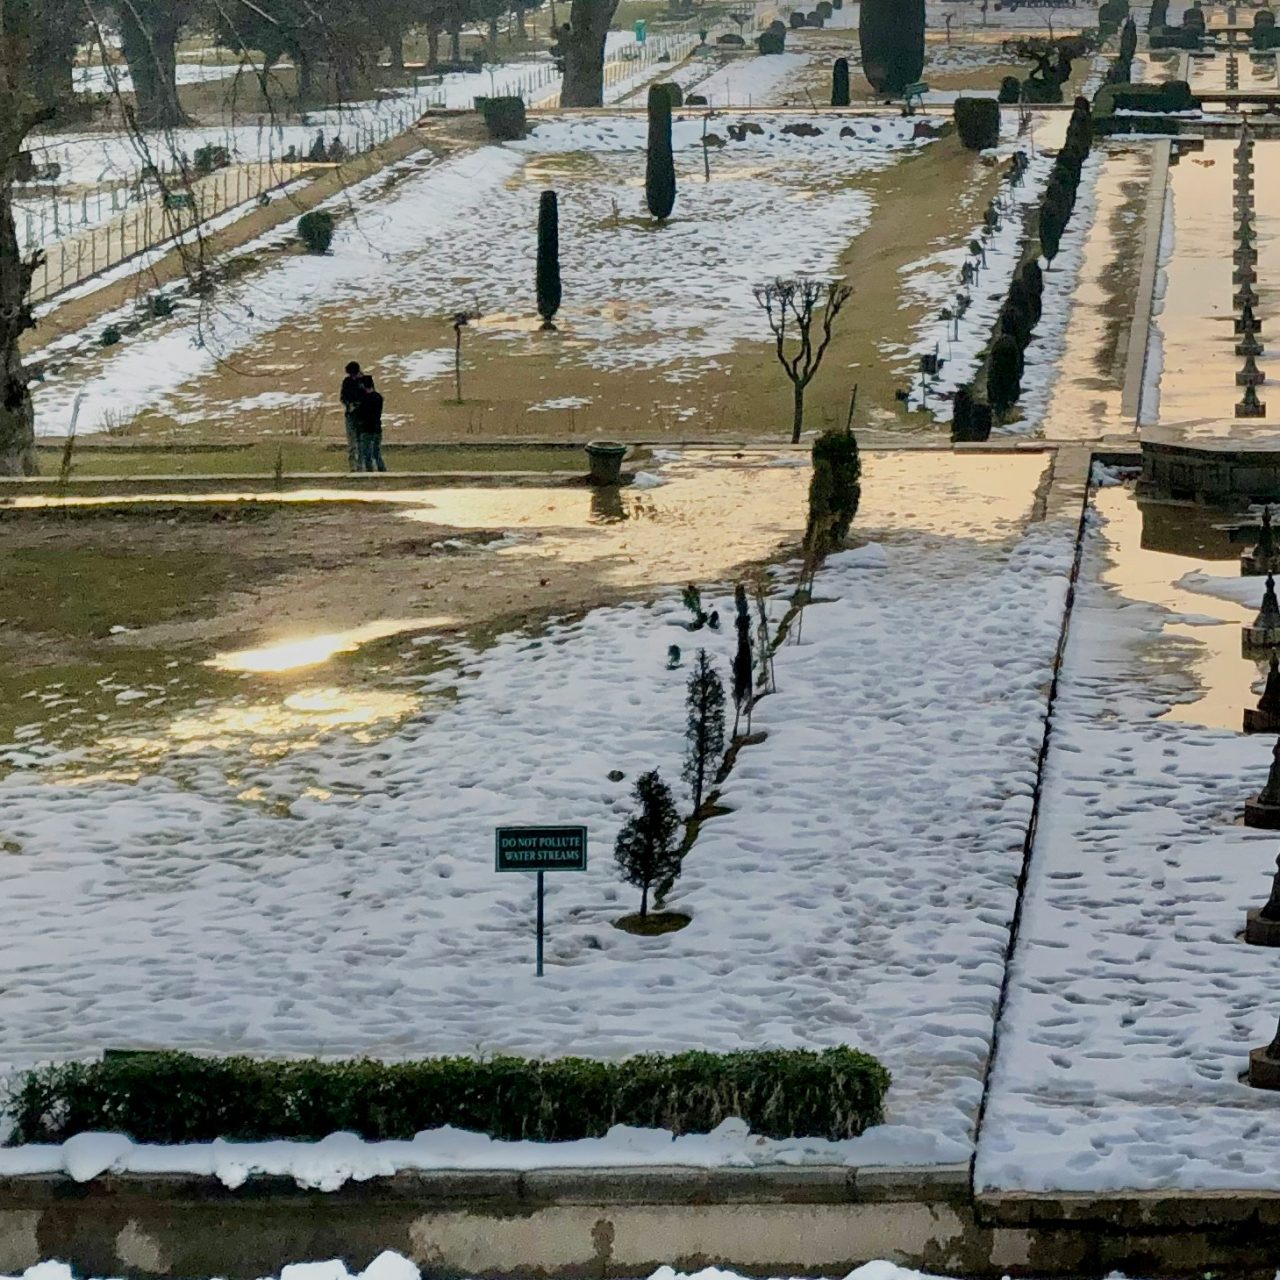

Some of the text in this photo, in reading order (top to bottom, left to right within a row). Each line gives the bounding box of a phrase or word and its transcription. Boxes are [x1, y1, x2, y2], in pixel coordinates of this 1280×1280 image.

[501, 836, 580, 848] DO NOT POLLUTE
[504, 850, 580, 861] WATER STREAMS
